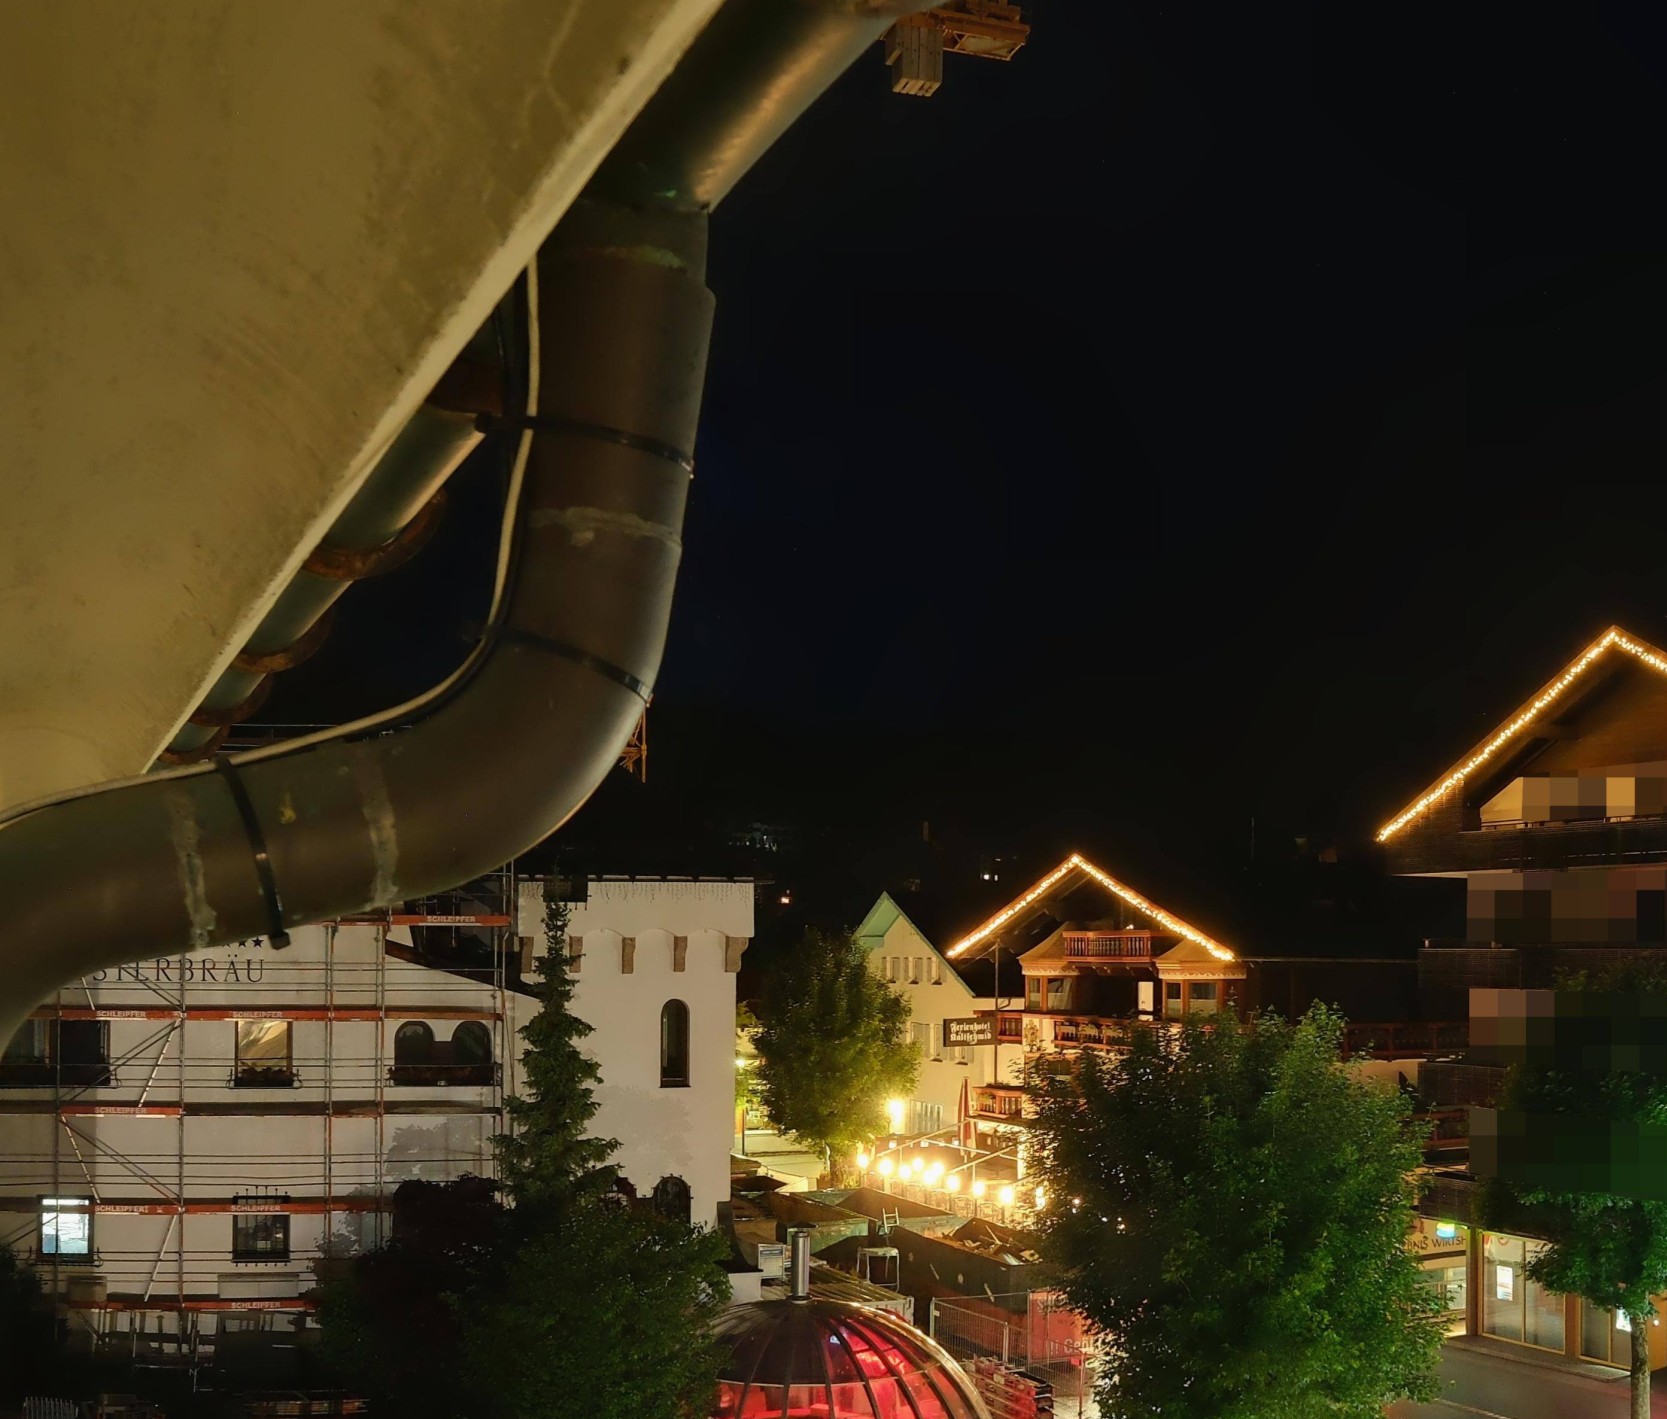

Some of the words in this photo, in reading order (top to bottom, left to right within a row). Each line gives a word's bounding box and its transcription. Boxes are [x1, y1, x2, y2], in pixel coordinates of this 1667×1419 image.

[426, 915, 476, 923] SCHLEIPFER
[96, 1010, 146, 1018] SCHLEIPFER
[232, 1010, 283, 1018] SCHLEIPFER
